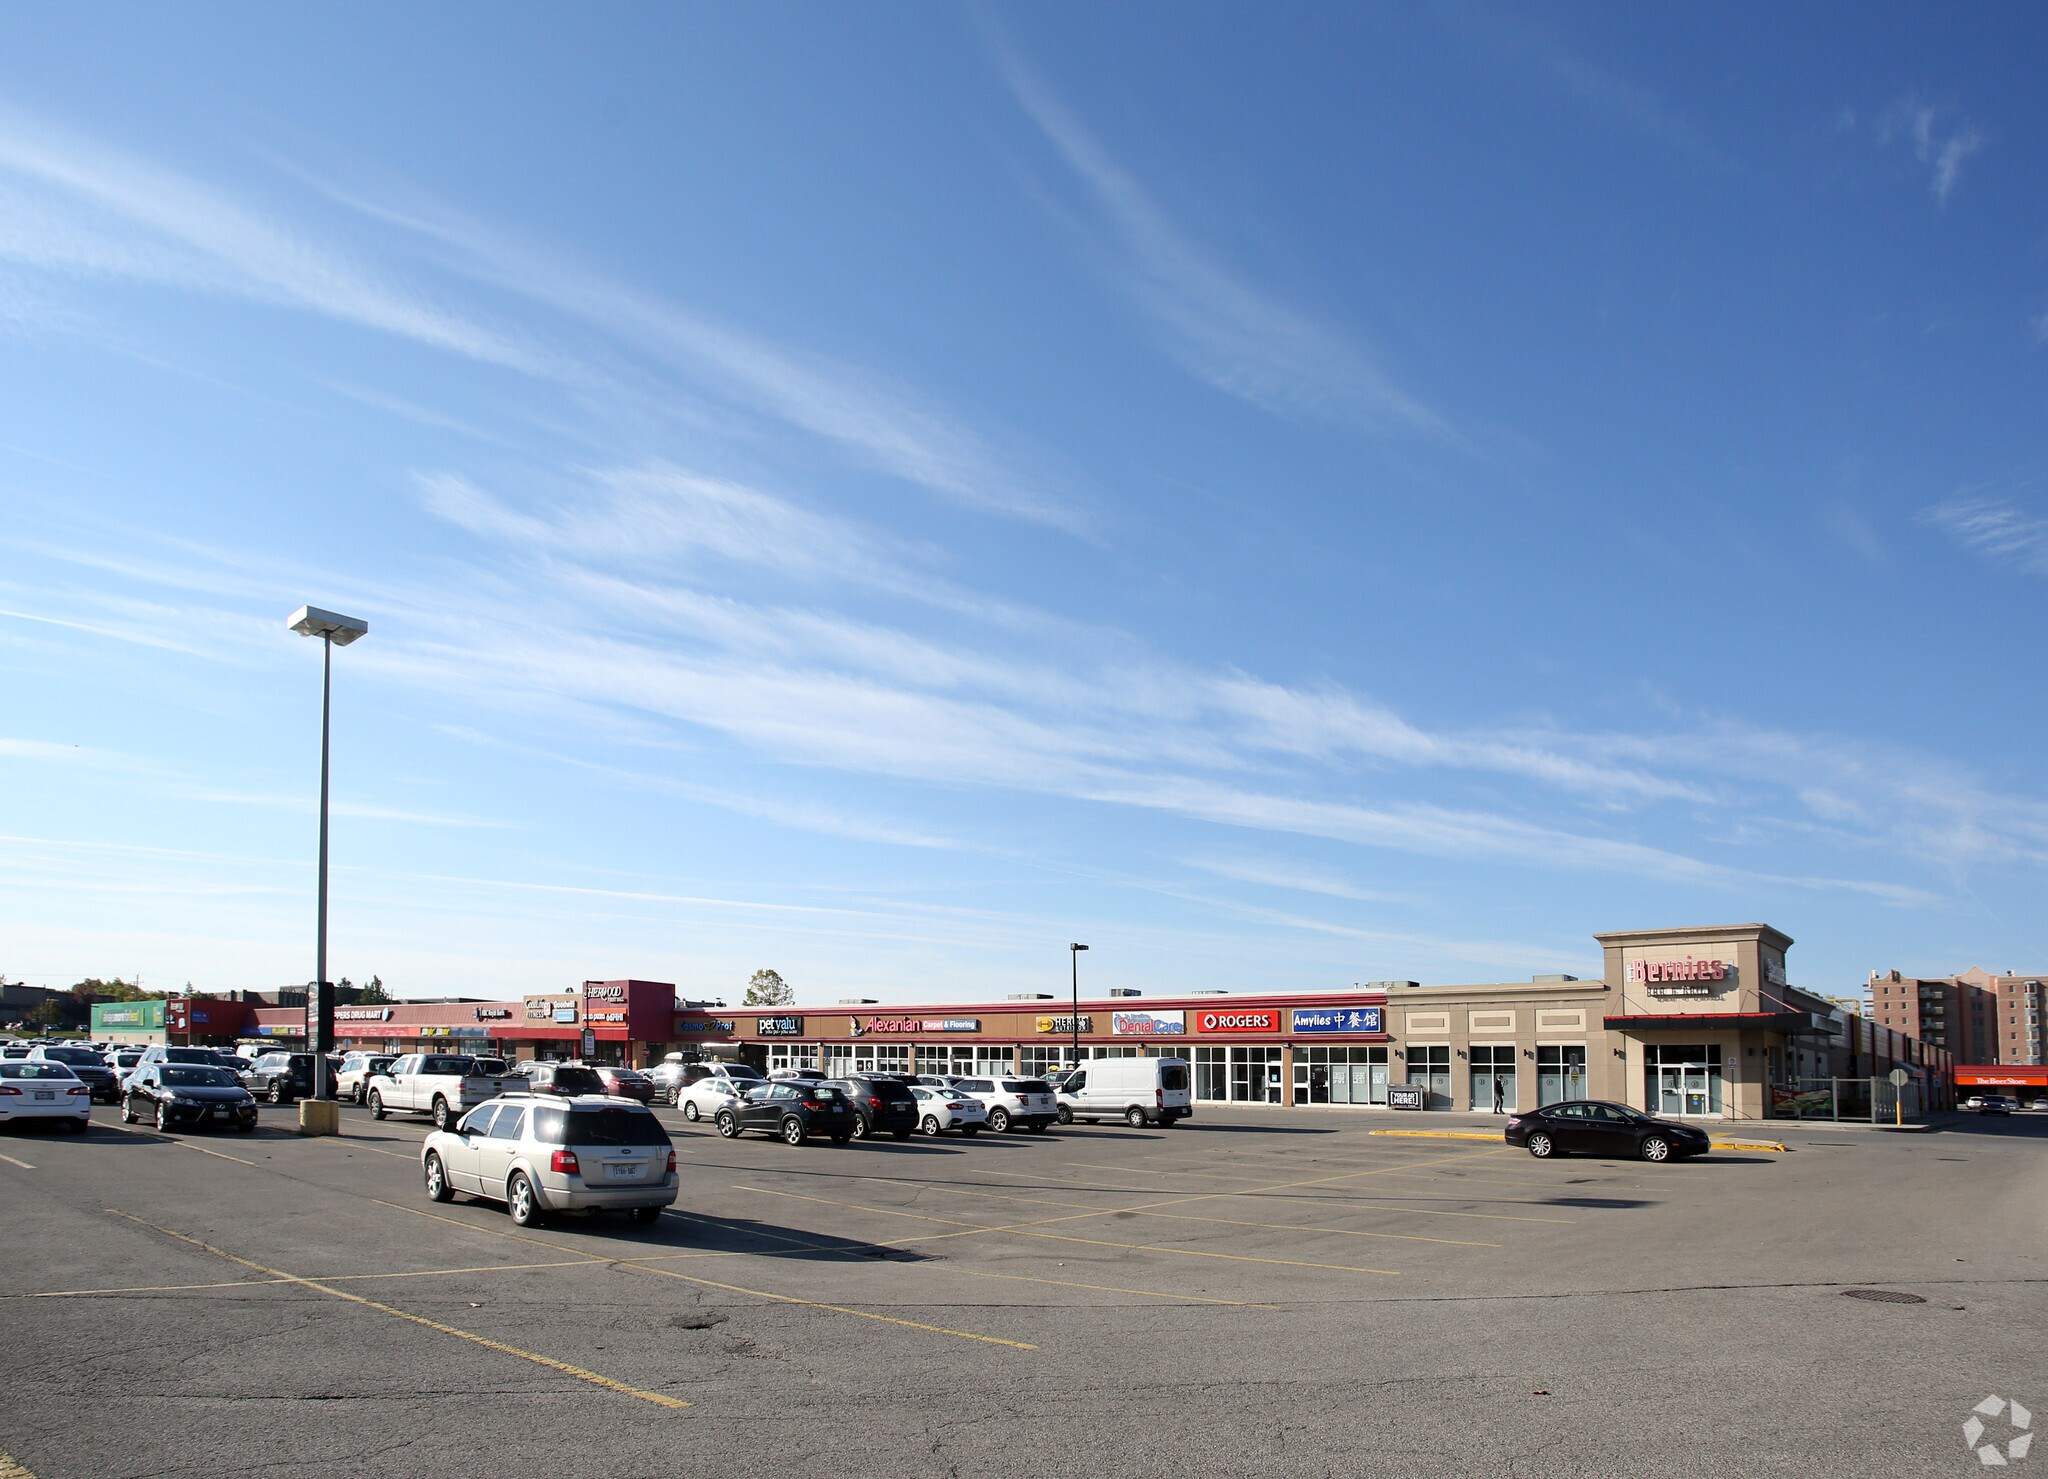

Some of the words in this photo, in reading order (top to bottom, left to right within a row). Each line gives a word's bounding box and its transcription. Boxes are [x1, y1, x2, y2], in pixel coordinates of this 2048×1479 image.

[1633, 956, 1724, 983] Bernies
[554, 1000, 575, 1008] Goodwill
[351, 1010, 366, 1019] DRUG
[366, 1010, 382, 1019] MART
[1219, 1014, 1269, 1027] ROGERS
[1294, 1014, 1331, 1027] Amylies
[1333, 1011, 1379, 1029] 中餐馆
[680, 1021, 704, 1031] Cosmo
[716, 1021, 733, 1031] Prof
[759, 1017, 774, 1033] pet
[775, 1017, 795, 1029] valu
[864, 1016, 920, 1032] Alexanian
[922, 1020, 943, 1029] Carpet
[944, 1020, 949, 1029] &
[950, 1020, 975, 1030] Flooring
[2007, 1077, 2027, 1085] Store
